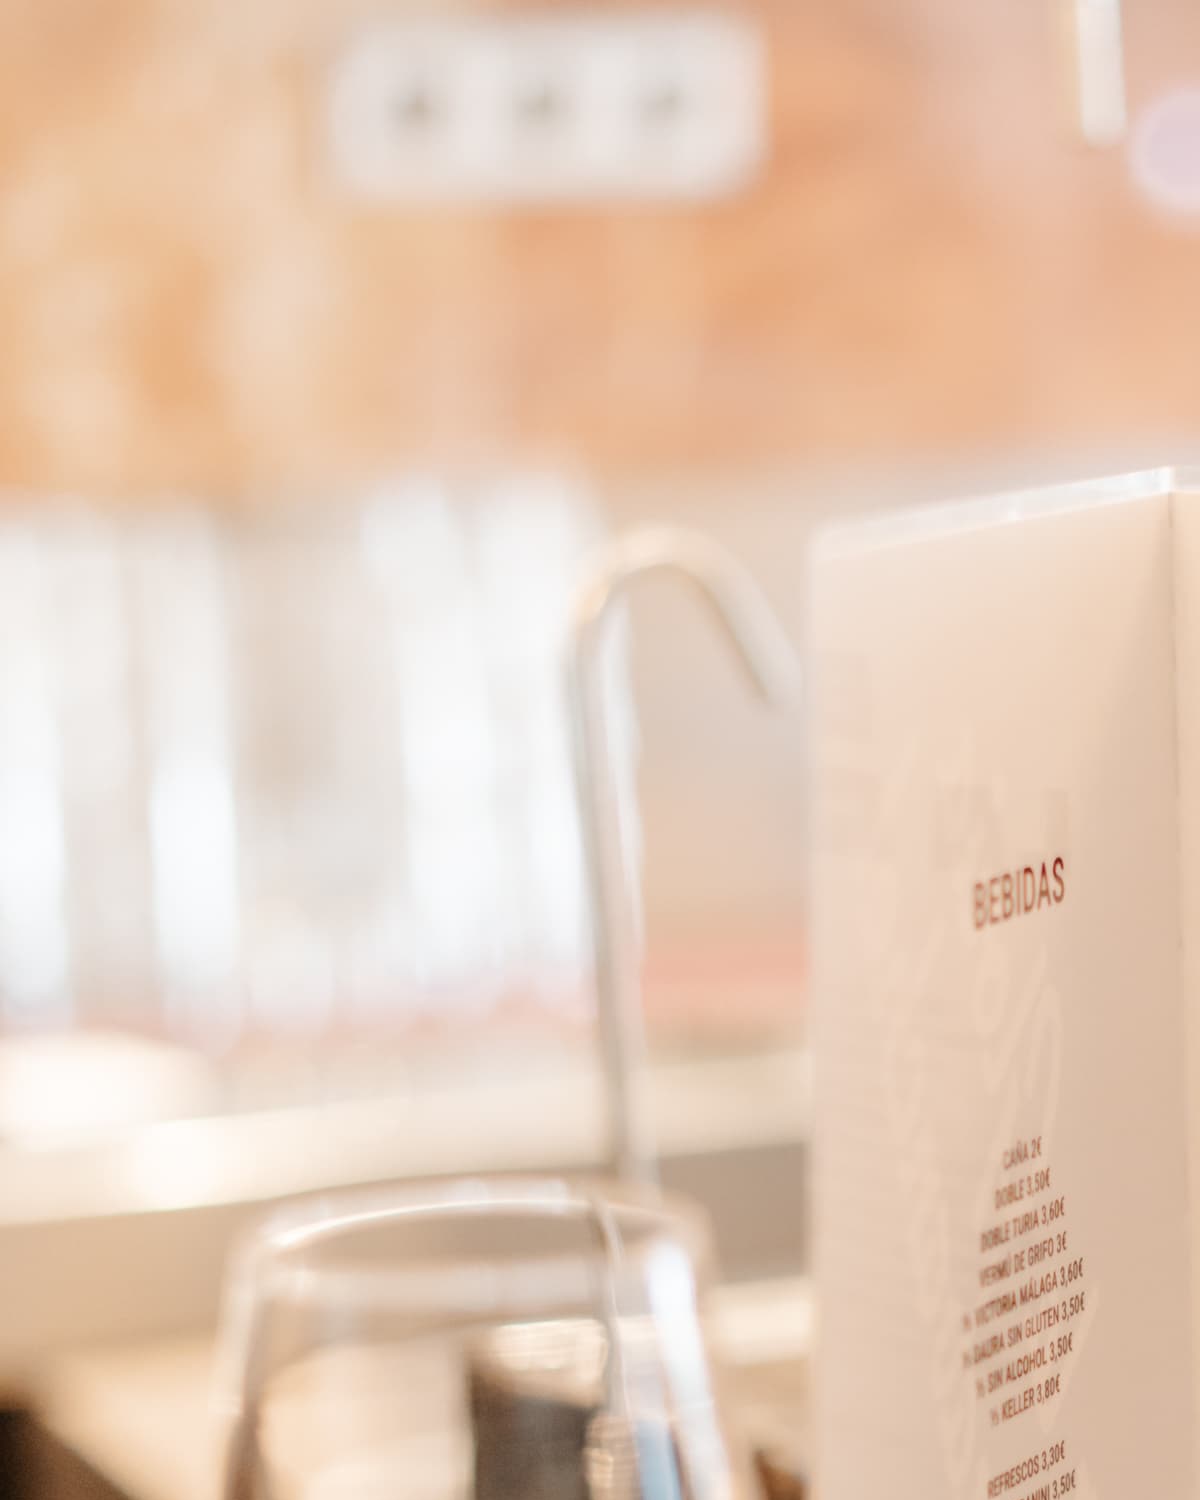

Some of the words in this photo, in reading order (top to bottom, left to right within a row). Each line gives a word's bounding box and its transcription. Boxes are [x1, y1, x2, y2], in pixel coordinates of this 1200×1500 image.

[973, 856, 1065, 931] BEBIDAS
[1003, 1140, 1029, 1170] CAÑA
[1030, 1135, 1042, 1159] 2€
[995, 1178, 1024, 1210] DOBLE
[1026, 1167, 1050, 1196] 3,50€
[980, 1221, 1010, 1252] DOBLE
[1012, 1209, 1039, 1237] TURIA
[1041, 1195, 1065, 1226] 3,60€
[1014, 1250, 1025, 1274] DE
[1027, 1237, 1054, 1267] GRIFO
[1056, 1230, 1067, 1254] 3€
[975, 1291, 1017, 1325] VICTORIA
[1019, 1271, 1058, 1305] MÁLAGA
[1060, 1256, 1083, 1288] 3,60€
[1007, 1323, 1022, 1348] SIN
[1025, 1303, 1059, 1338] GLUTEN
[1061, 1291, 1085, 1321] 3,50€
[988, 1369, 1003, 1393] SIN
[1005, 1346, 1048, 1383] ALCOHOL
[1049, 1331, 1072, 1362] 3,50€
[1001, 1388, 1035, 1421] KELLER
[1036, 1373, 1060, 1404] 3,80€
[987, 1454, 1040, 1498] REFRESCOS
[1041, 1439, 1065, 1471] 3,30€
[1052, 1468, 1076, 1500] 3,50€
